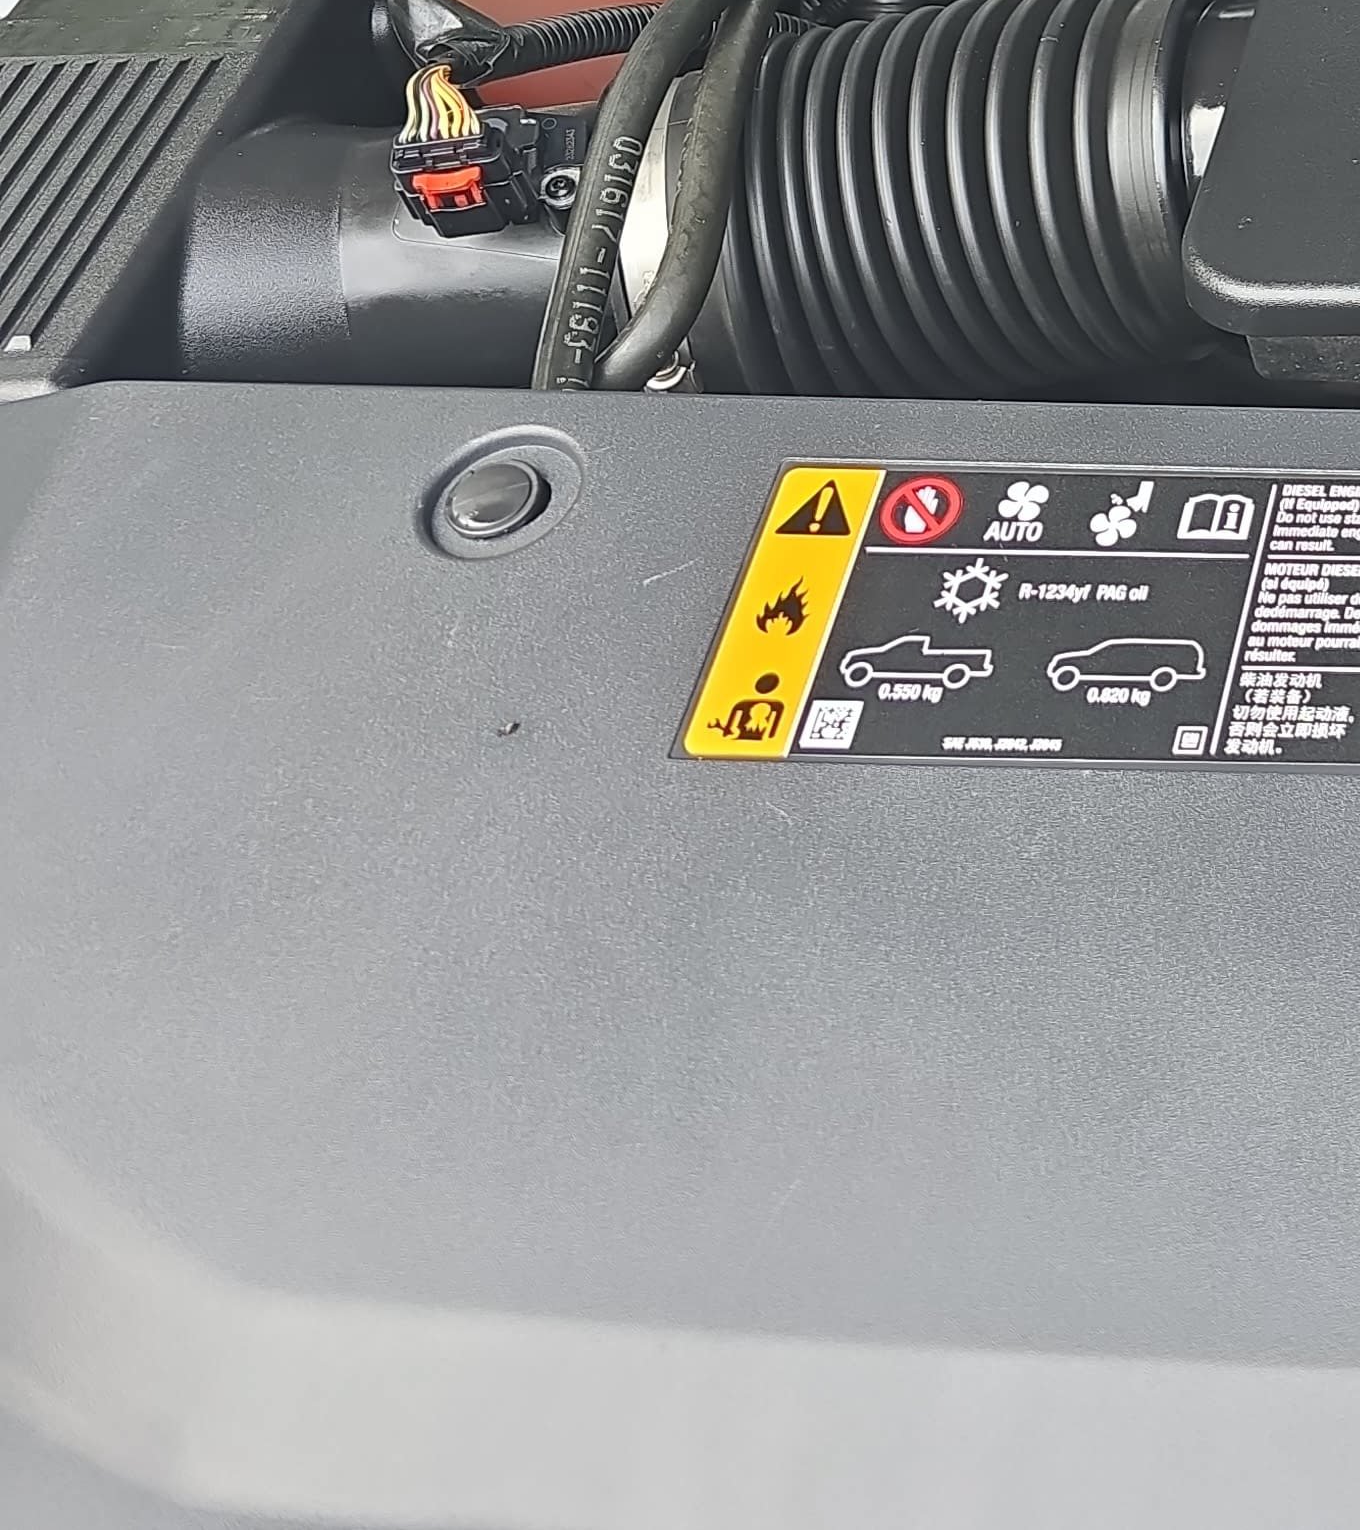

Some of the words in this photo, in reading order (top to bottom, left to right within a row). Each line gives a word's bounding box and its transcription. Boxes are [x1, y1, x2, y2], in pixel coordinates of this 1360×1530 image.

[1282, 484, 1327, 497] DIESEL
[1296, 499, 1360, 512] Equipped)
[1276, 511, 1294, 523] Do
[1296, 512, 1317, 523] not
[1319, 515, 1341, 524] use
[982, 521, 1043, 542] AUTO
[1273, 525, 1339, 538] Immediate
[1270, 541, 1293, 551] can
[1295, 539, 1335, 551] result.
[1264, 563, 1319, 576] MOTEUR
[1261, 577, 1278, 591] (si
[1280, 577, 1330, 592] équipé)
[1018, 582, 1091, 604] R-1234yf
[1096, 584, 1127, 601] PAG
[1129, 585, 1149, 601] oil
[1258, 591, 1276, 604] Ne
[1278, 595, 1301, 606] pas
[1304, 592, 1349, 605] utiliser
[1251, 620, 1322, 635] dommages
[1247, 636, 1265, 647] au
[1267, 636, 1314, 648] moteur
[1239, 672, 1323, 688] 柴油发动机
[922, 684, 944, 704] kg
[1130, 688, 1151, 707] kg
[1228, 721, 1348, 740] 否则会立即损坏
